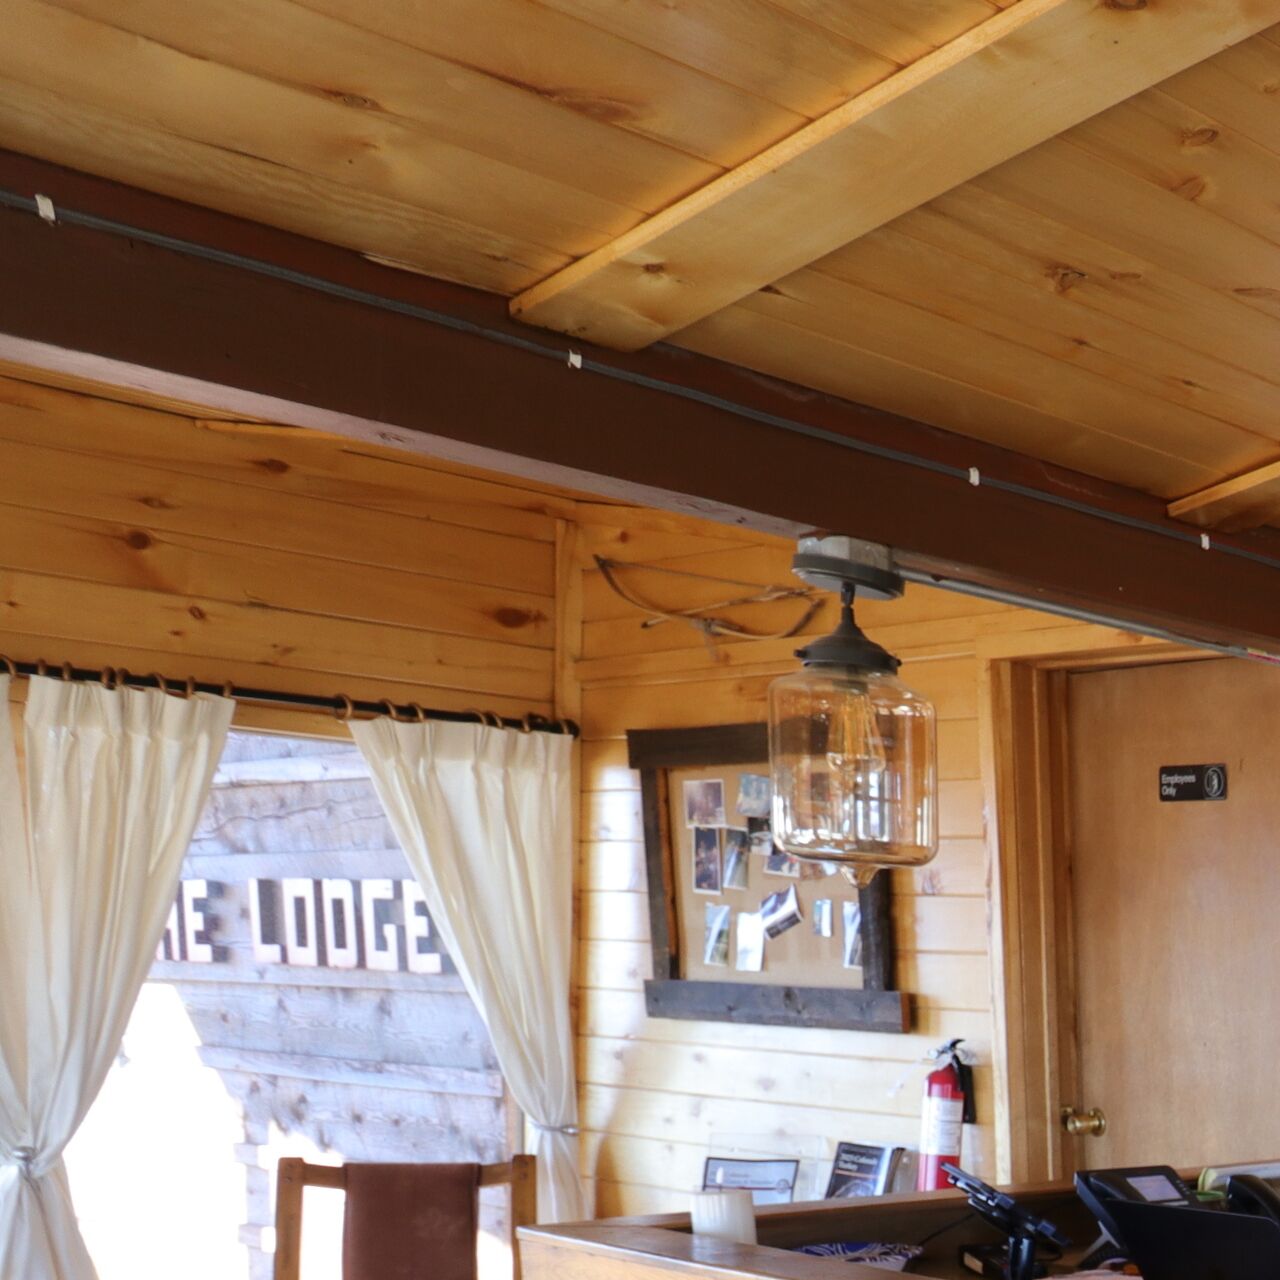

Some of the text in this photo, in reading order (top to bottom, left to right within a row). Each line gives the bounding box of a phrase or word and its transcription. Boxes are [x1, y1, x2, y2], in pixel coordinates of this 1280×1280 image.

[1162, 774, 1196, 784] Employees
[1162, 786, 1176, 797] Only
[248, 878, 442, 974] LODGE
